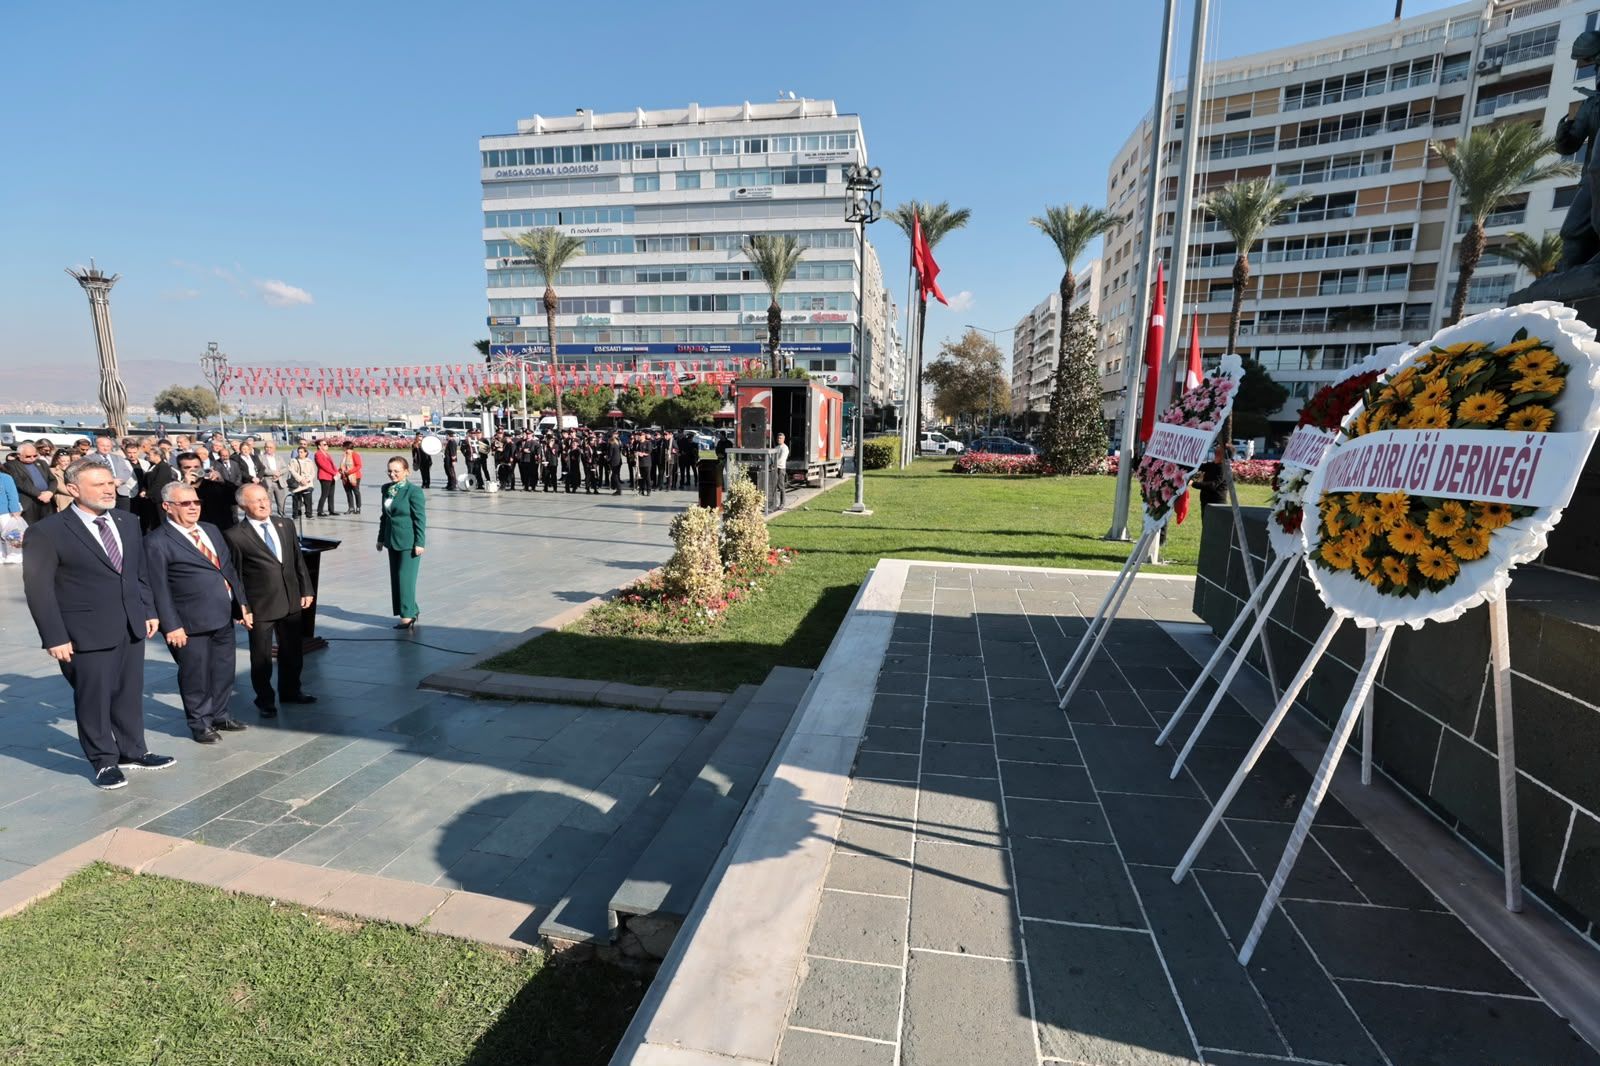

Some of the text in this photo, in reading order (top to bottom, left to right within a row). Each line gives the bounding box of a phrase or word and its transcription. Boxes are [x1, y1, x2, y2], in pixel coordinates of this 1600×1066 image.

[496, 164, 599, 178] OMEGA GLOBAL LOGISTICS
[1153, 430, 1207, 465] FEDERASYONU
[1366, 432, 1441, 491] BİRLİĞİ
[1433, 434, 1547, 500] DERNEĞİ
